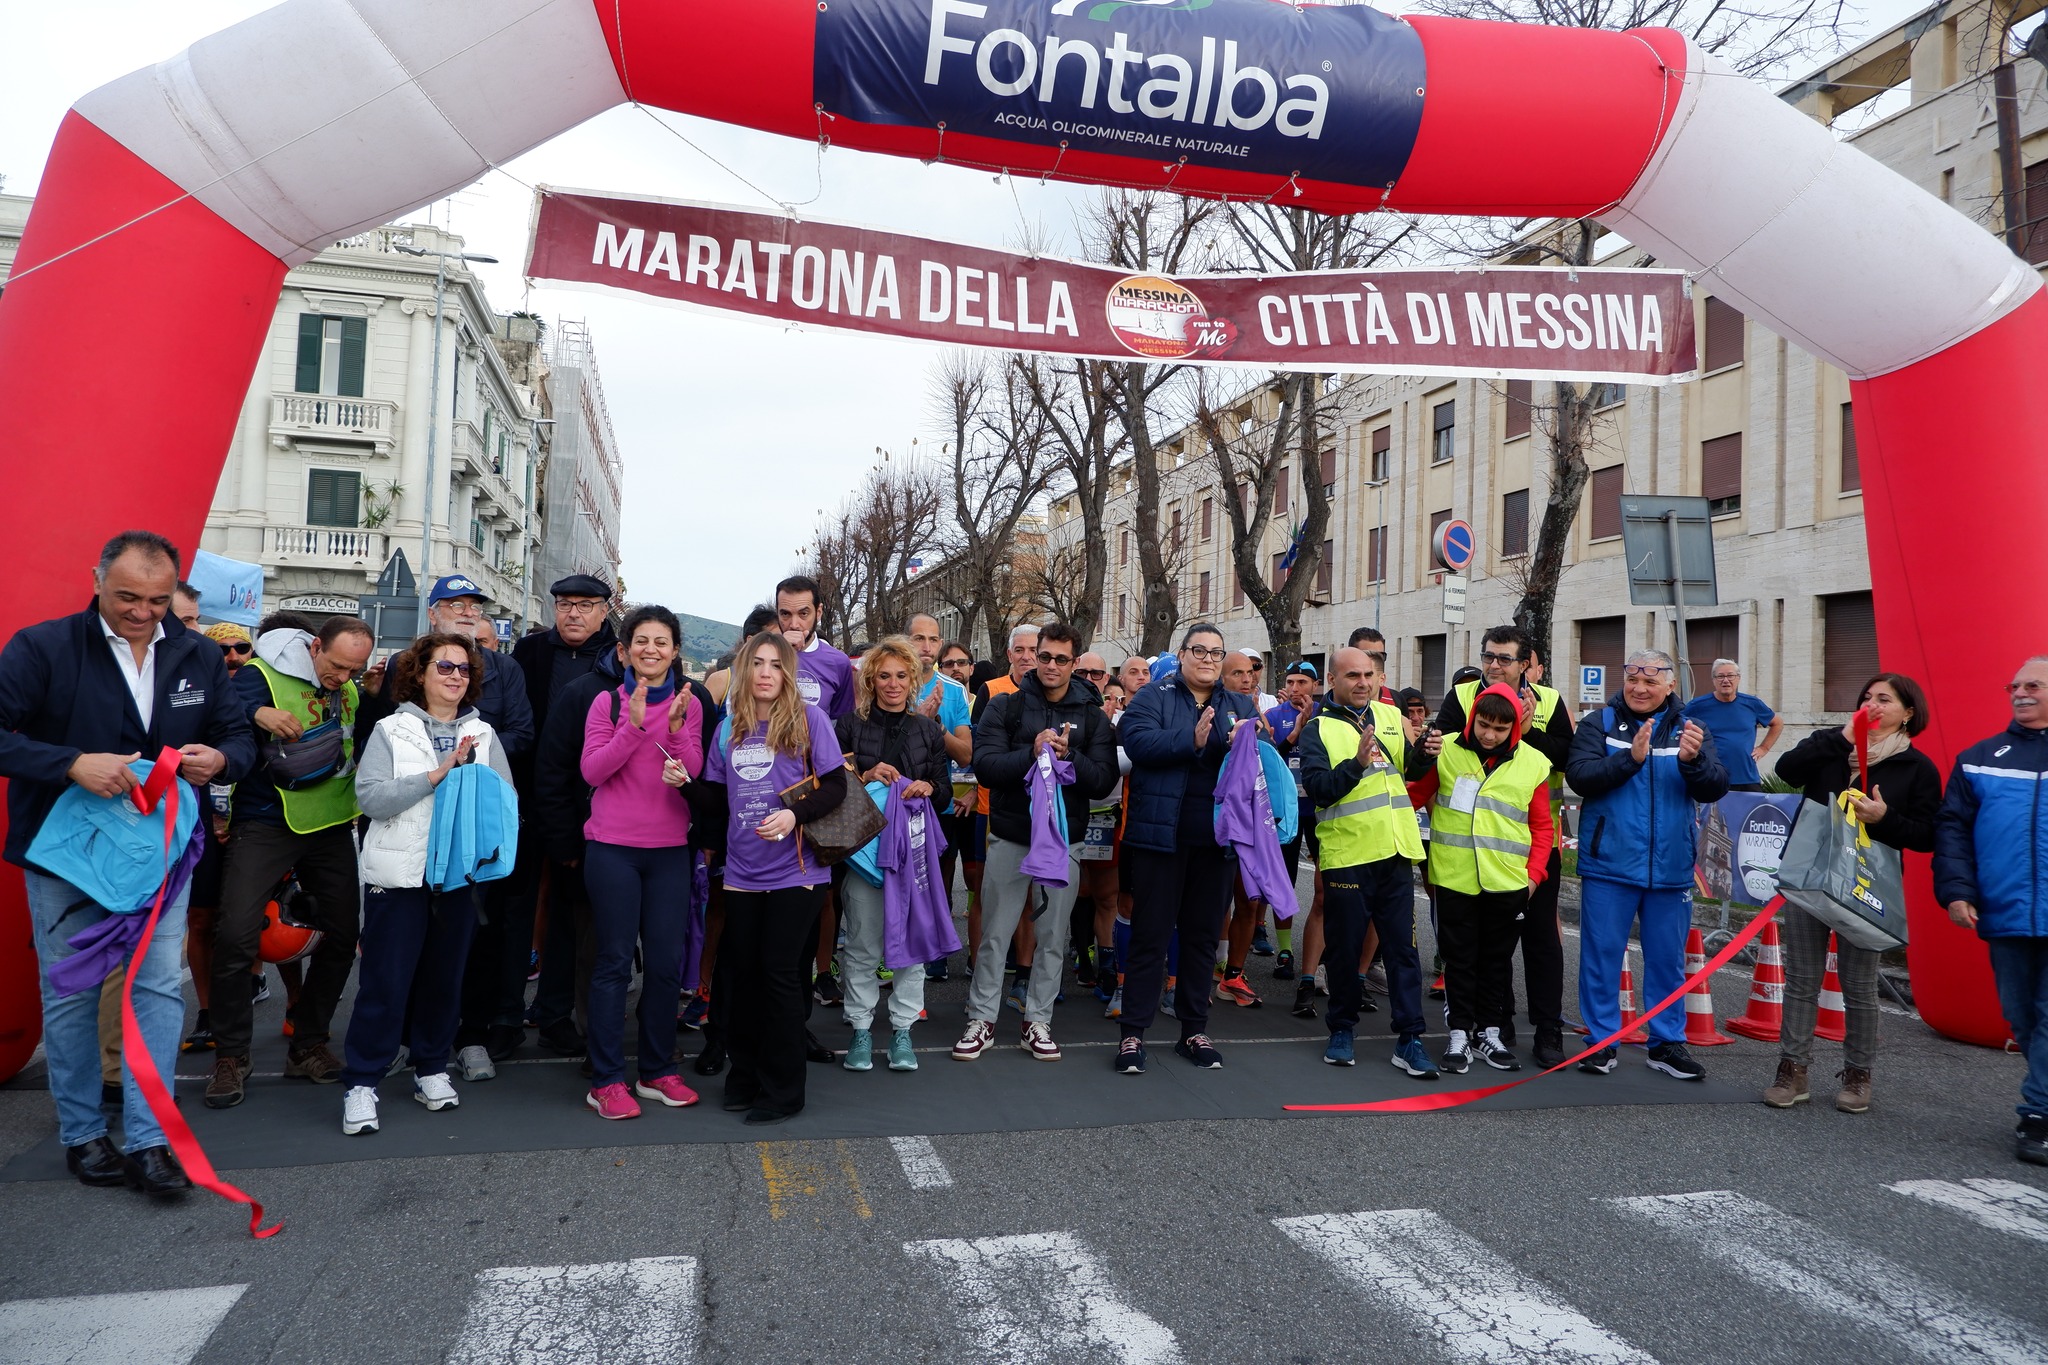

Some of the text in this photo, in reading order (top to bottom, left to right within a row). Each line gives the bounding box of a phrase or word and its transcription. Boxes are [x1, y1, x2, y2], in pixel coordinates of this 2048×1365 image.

[924, 0, 1330, 140] Fontalba
[994, 112, 1250, 157] ACQUA OLIGOMINERALE NATURALE
[592, 222, 1664, 353] MARATONA DELLA CITTÀ DI MESSINA
[1118, 286, 1194, 303] MESSINA
[1213, 320, 1225, 328] to
[1195, 329, 1227, 346] Me
[1138, 346, 1187, 355] MESSINA
[296, 598, 356, 609] TABACCHI
[1587, 670, 1598, 683] P
[1749, 820, 1786, 834] Fontalba
